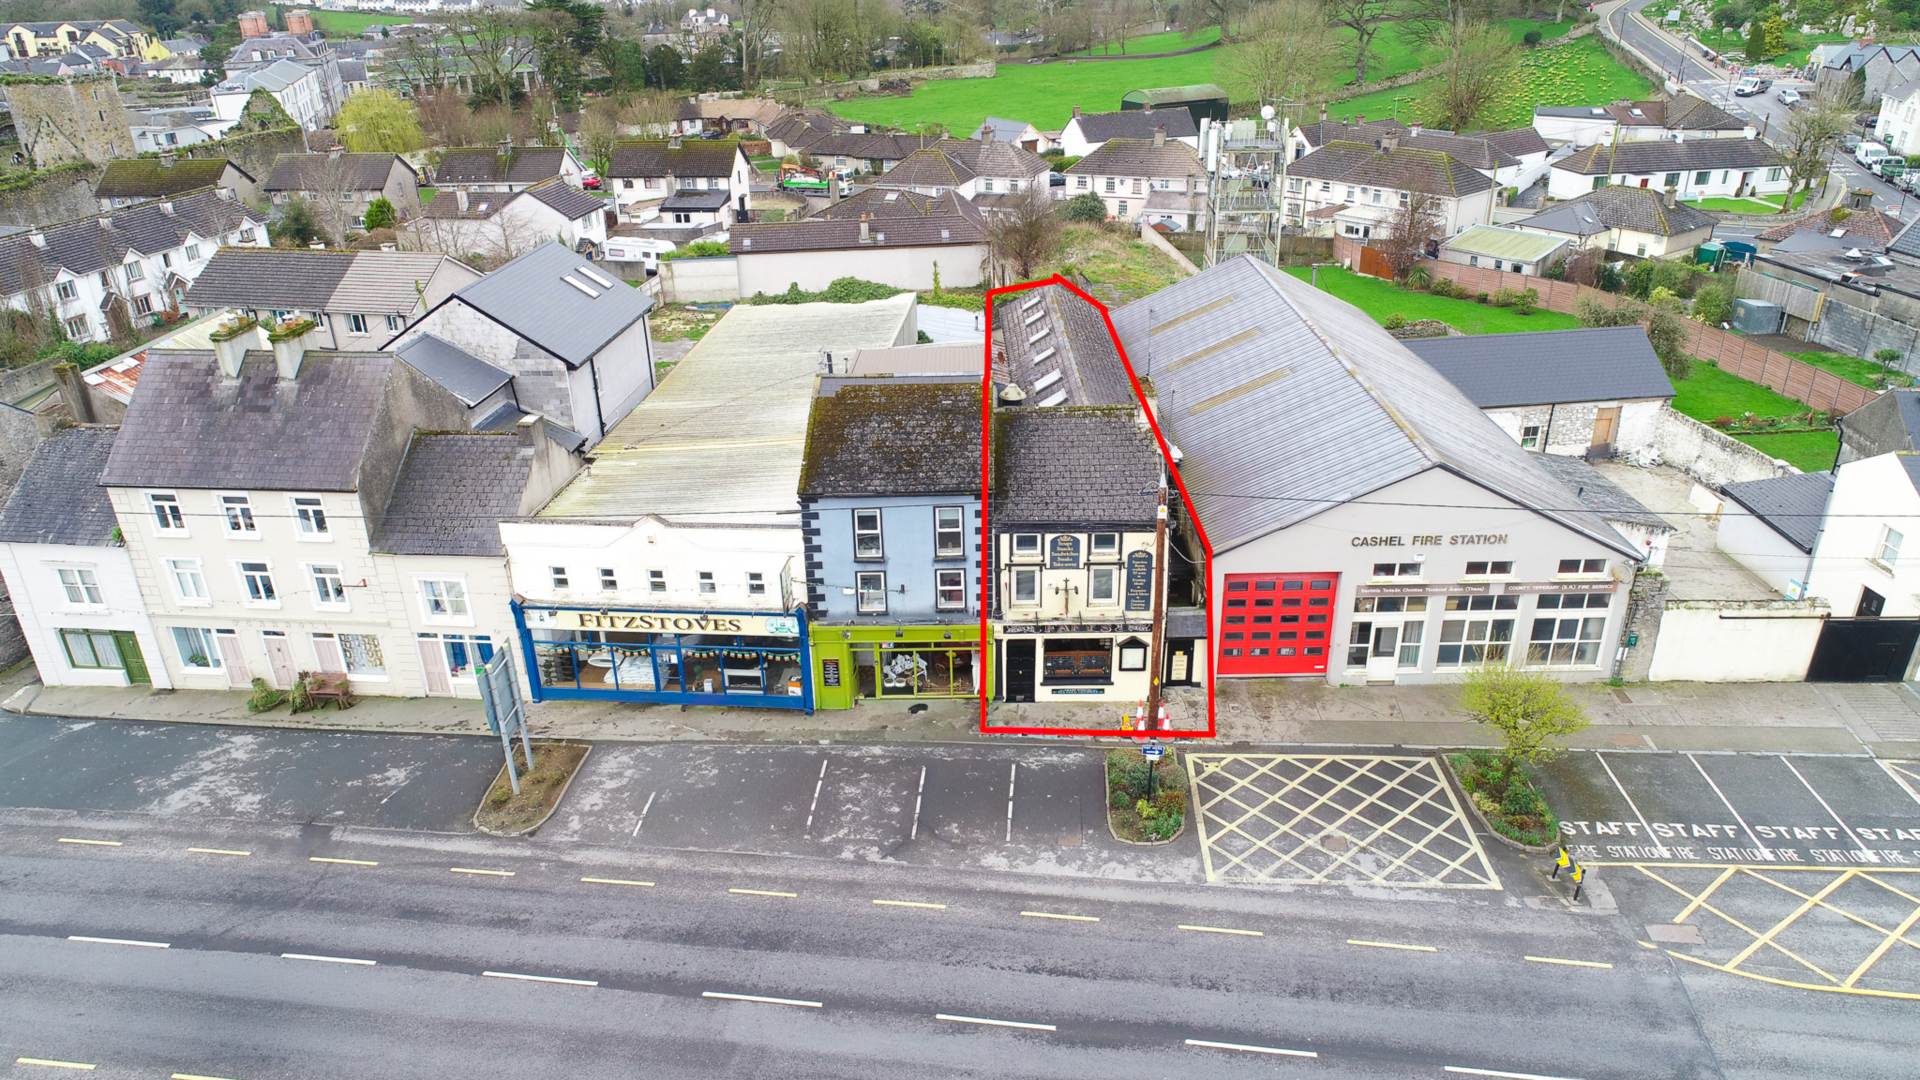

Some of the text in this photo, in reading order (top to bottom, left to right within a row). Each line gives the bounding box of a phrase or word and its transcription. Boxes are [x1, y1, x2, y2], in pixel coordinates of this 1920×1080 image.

[1351, 534, 1508, 547] CASHEL FIRE STATION
[578, 613, 743, 632] FITZSTOVES
[1559, 821, 1641, 836] STAFF
[1652, 822, 1738, 838] STAFF
[1754, 825, 1840, 840] STAFF
